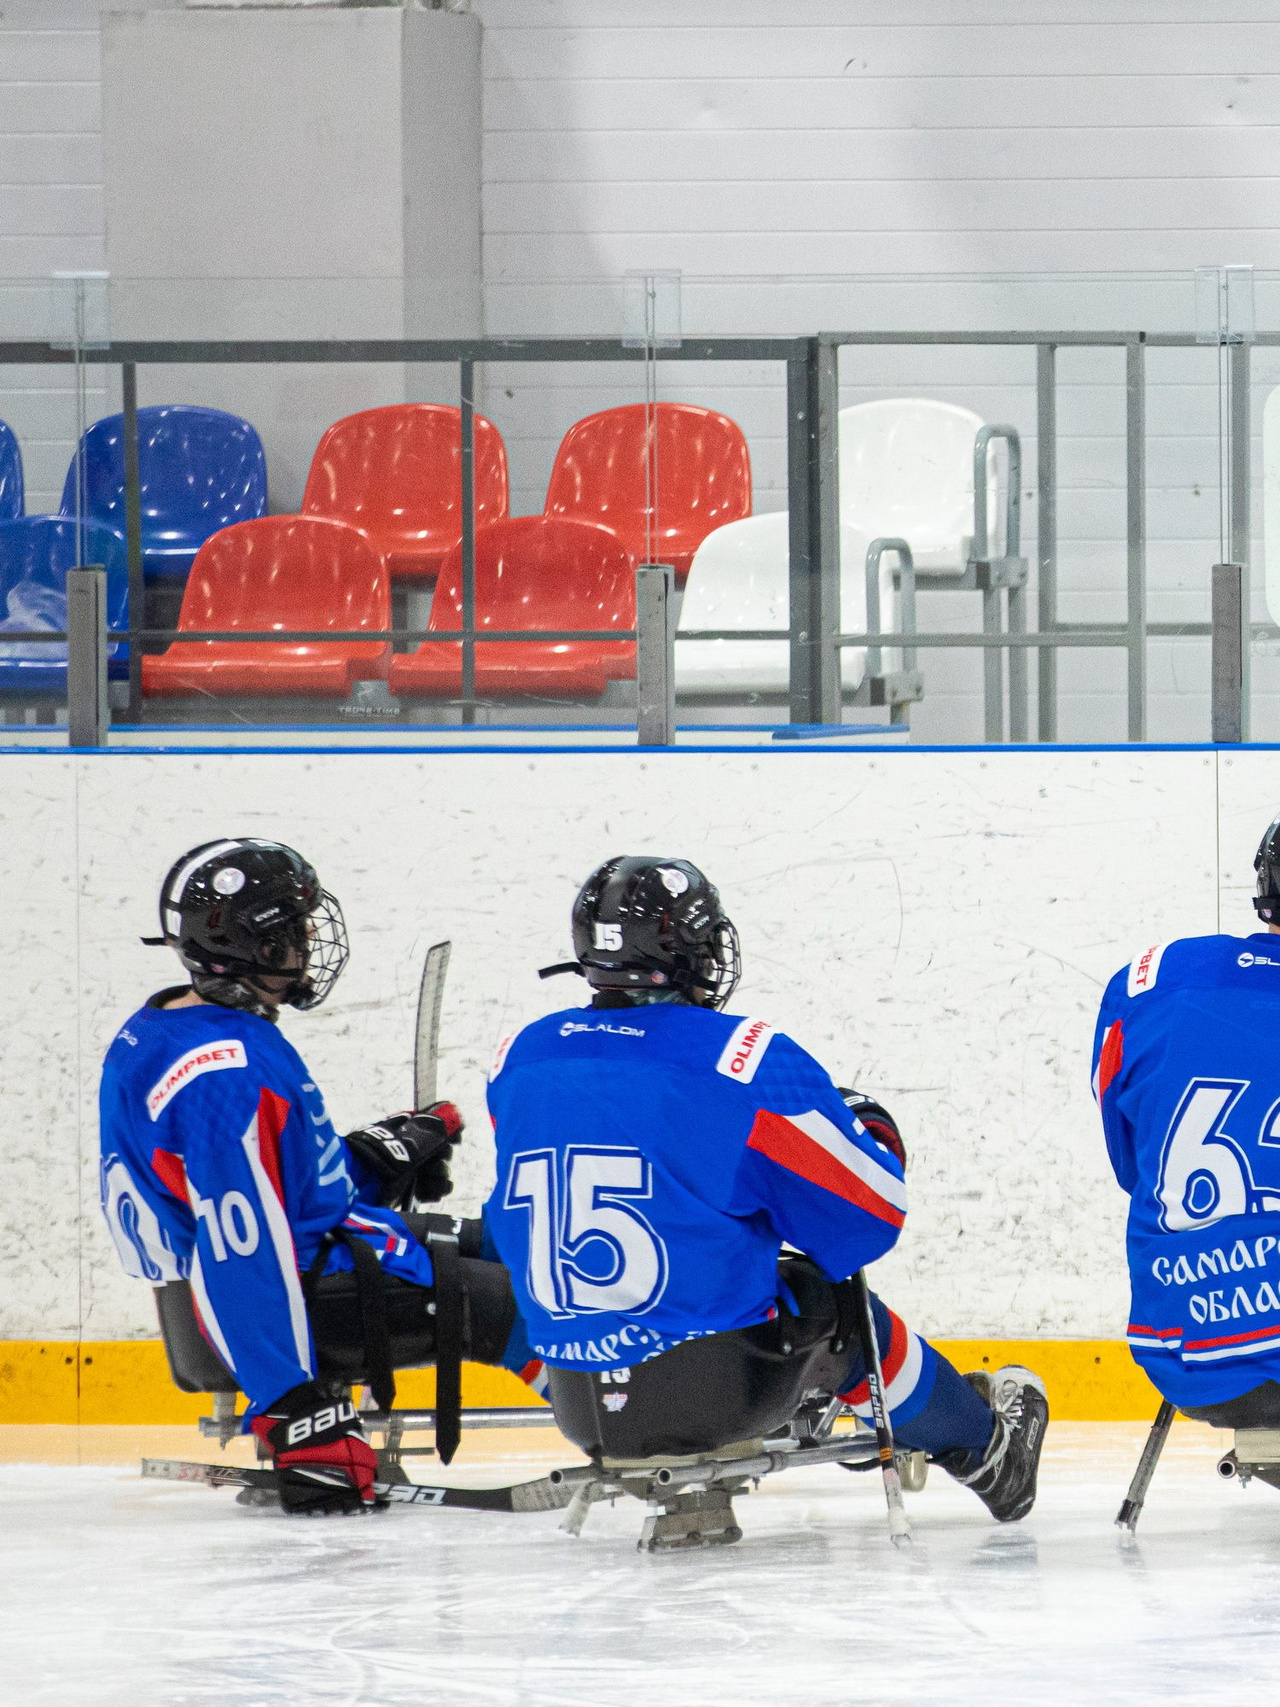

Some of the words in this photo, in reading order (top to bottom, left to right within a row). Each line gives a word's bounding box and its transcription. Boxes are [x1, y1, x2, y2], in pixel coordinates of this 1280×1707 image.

[594, 922, 624, 951] 15
[1136, 945, 1161, 986] PBET
[573, 1023, 646, 1038] SLALOM
[730, 1021, 771, 1074] OLIMP
[151, 1048, 238, 1110] OLIMPBET
[198, 1190, 260, 1263] 10
[505, 1144, 668, 1320] 15
[287, 1402, 361, 1446] BAU
